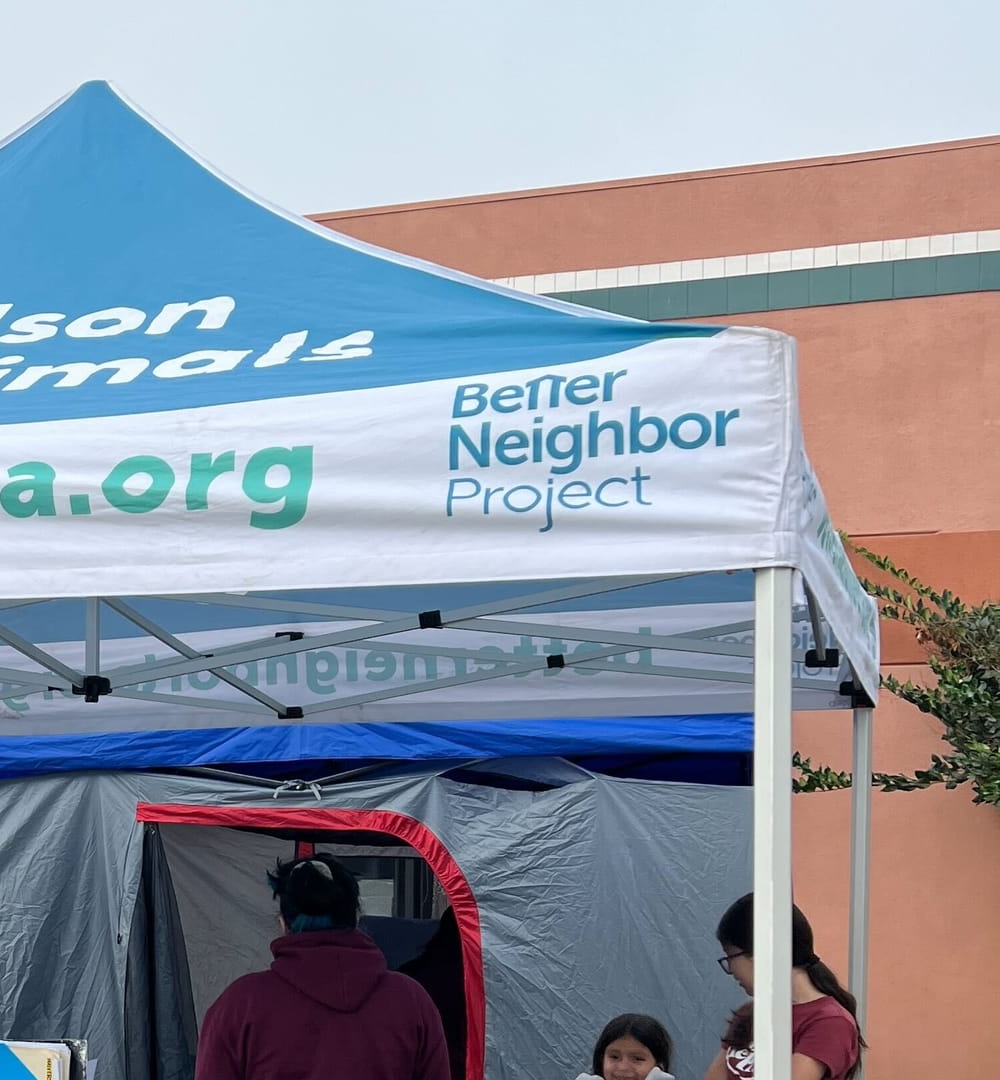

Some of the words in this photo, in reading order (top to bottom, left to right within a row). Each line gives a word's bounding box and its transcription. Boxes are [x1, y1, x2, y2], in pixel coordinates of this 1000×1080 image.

[452, 369, 628, 419] Better
[449, 407, 740, 475] Neighbor
[446, 467, 653, 533] Project
